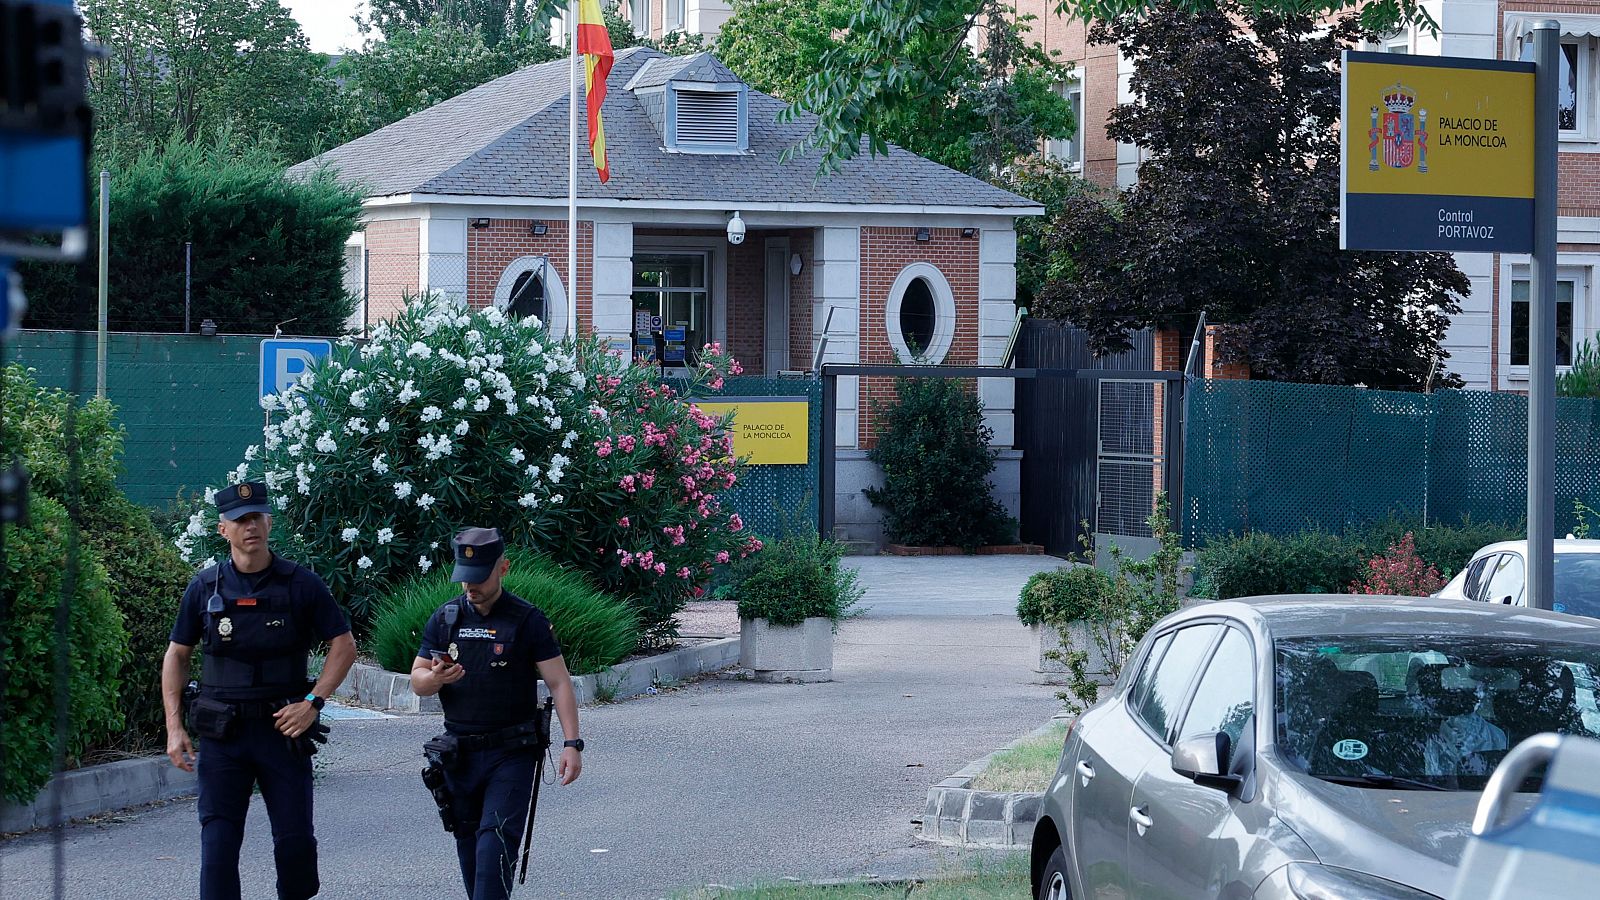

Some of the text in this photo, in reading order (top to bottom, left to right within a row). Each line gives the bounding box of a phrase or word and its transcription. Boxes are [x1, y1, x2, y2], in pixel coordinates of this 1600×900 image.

[1439, 117, 1498, 131] PALACIO DE
[1439, 134, 1507, 148] LA MONCLOA
[1438, 208, 1473, 223] Control
[1438, 225, 1495, 239] PORTAVOZ
[276, 348, 316, 393] P
